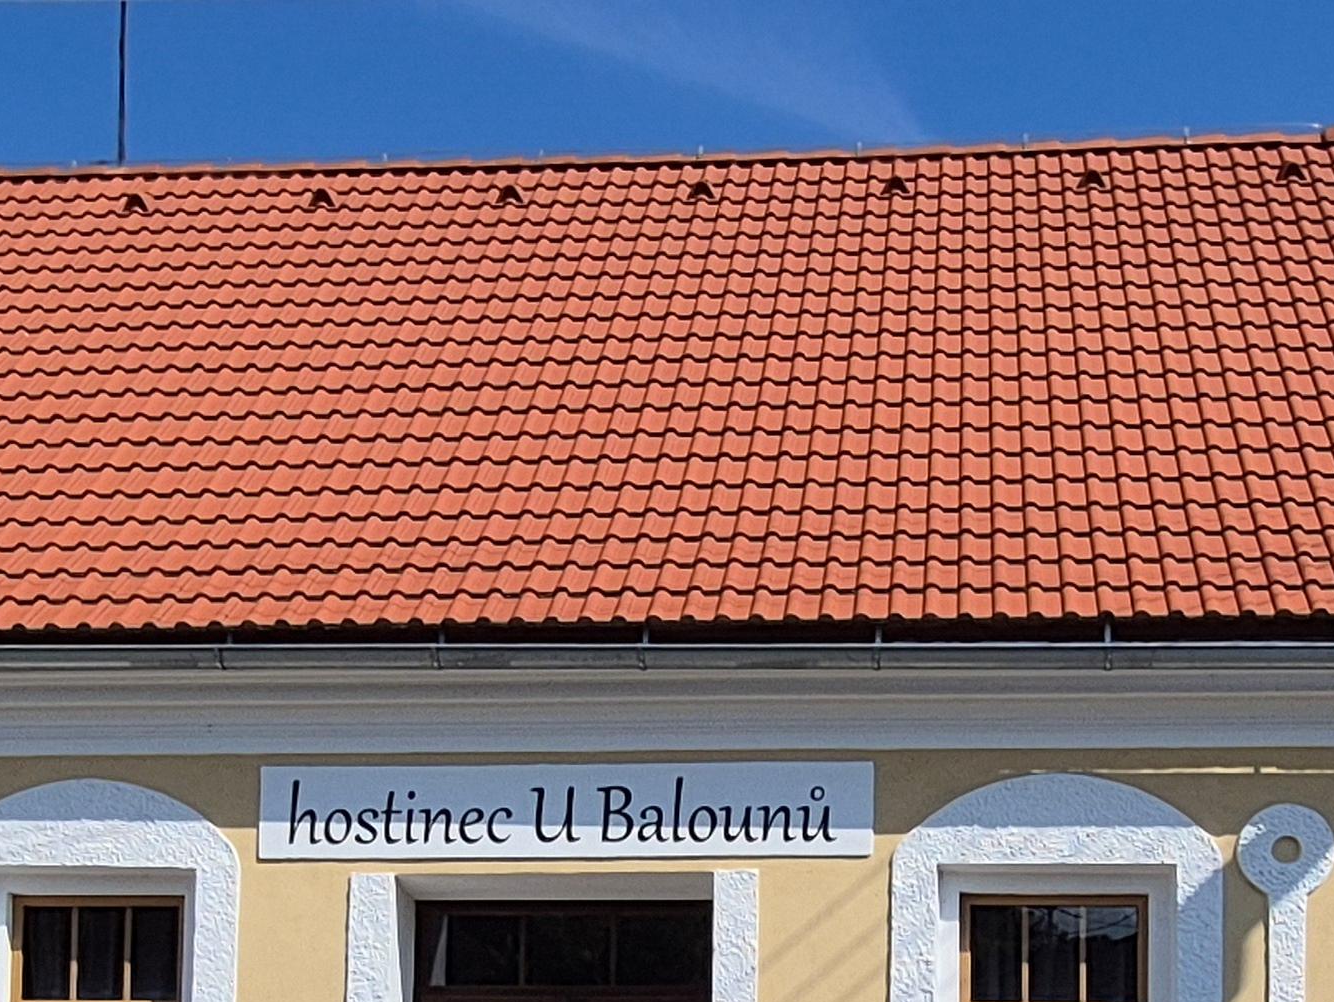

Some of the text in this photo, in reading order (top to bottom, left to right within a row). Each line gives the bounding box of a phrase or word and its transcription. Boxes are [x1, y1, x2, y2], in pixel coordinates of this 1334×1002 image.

[288, 776, 836, 845] hostinec U Balounů
